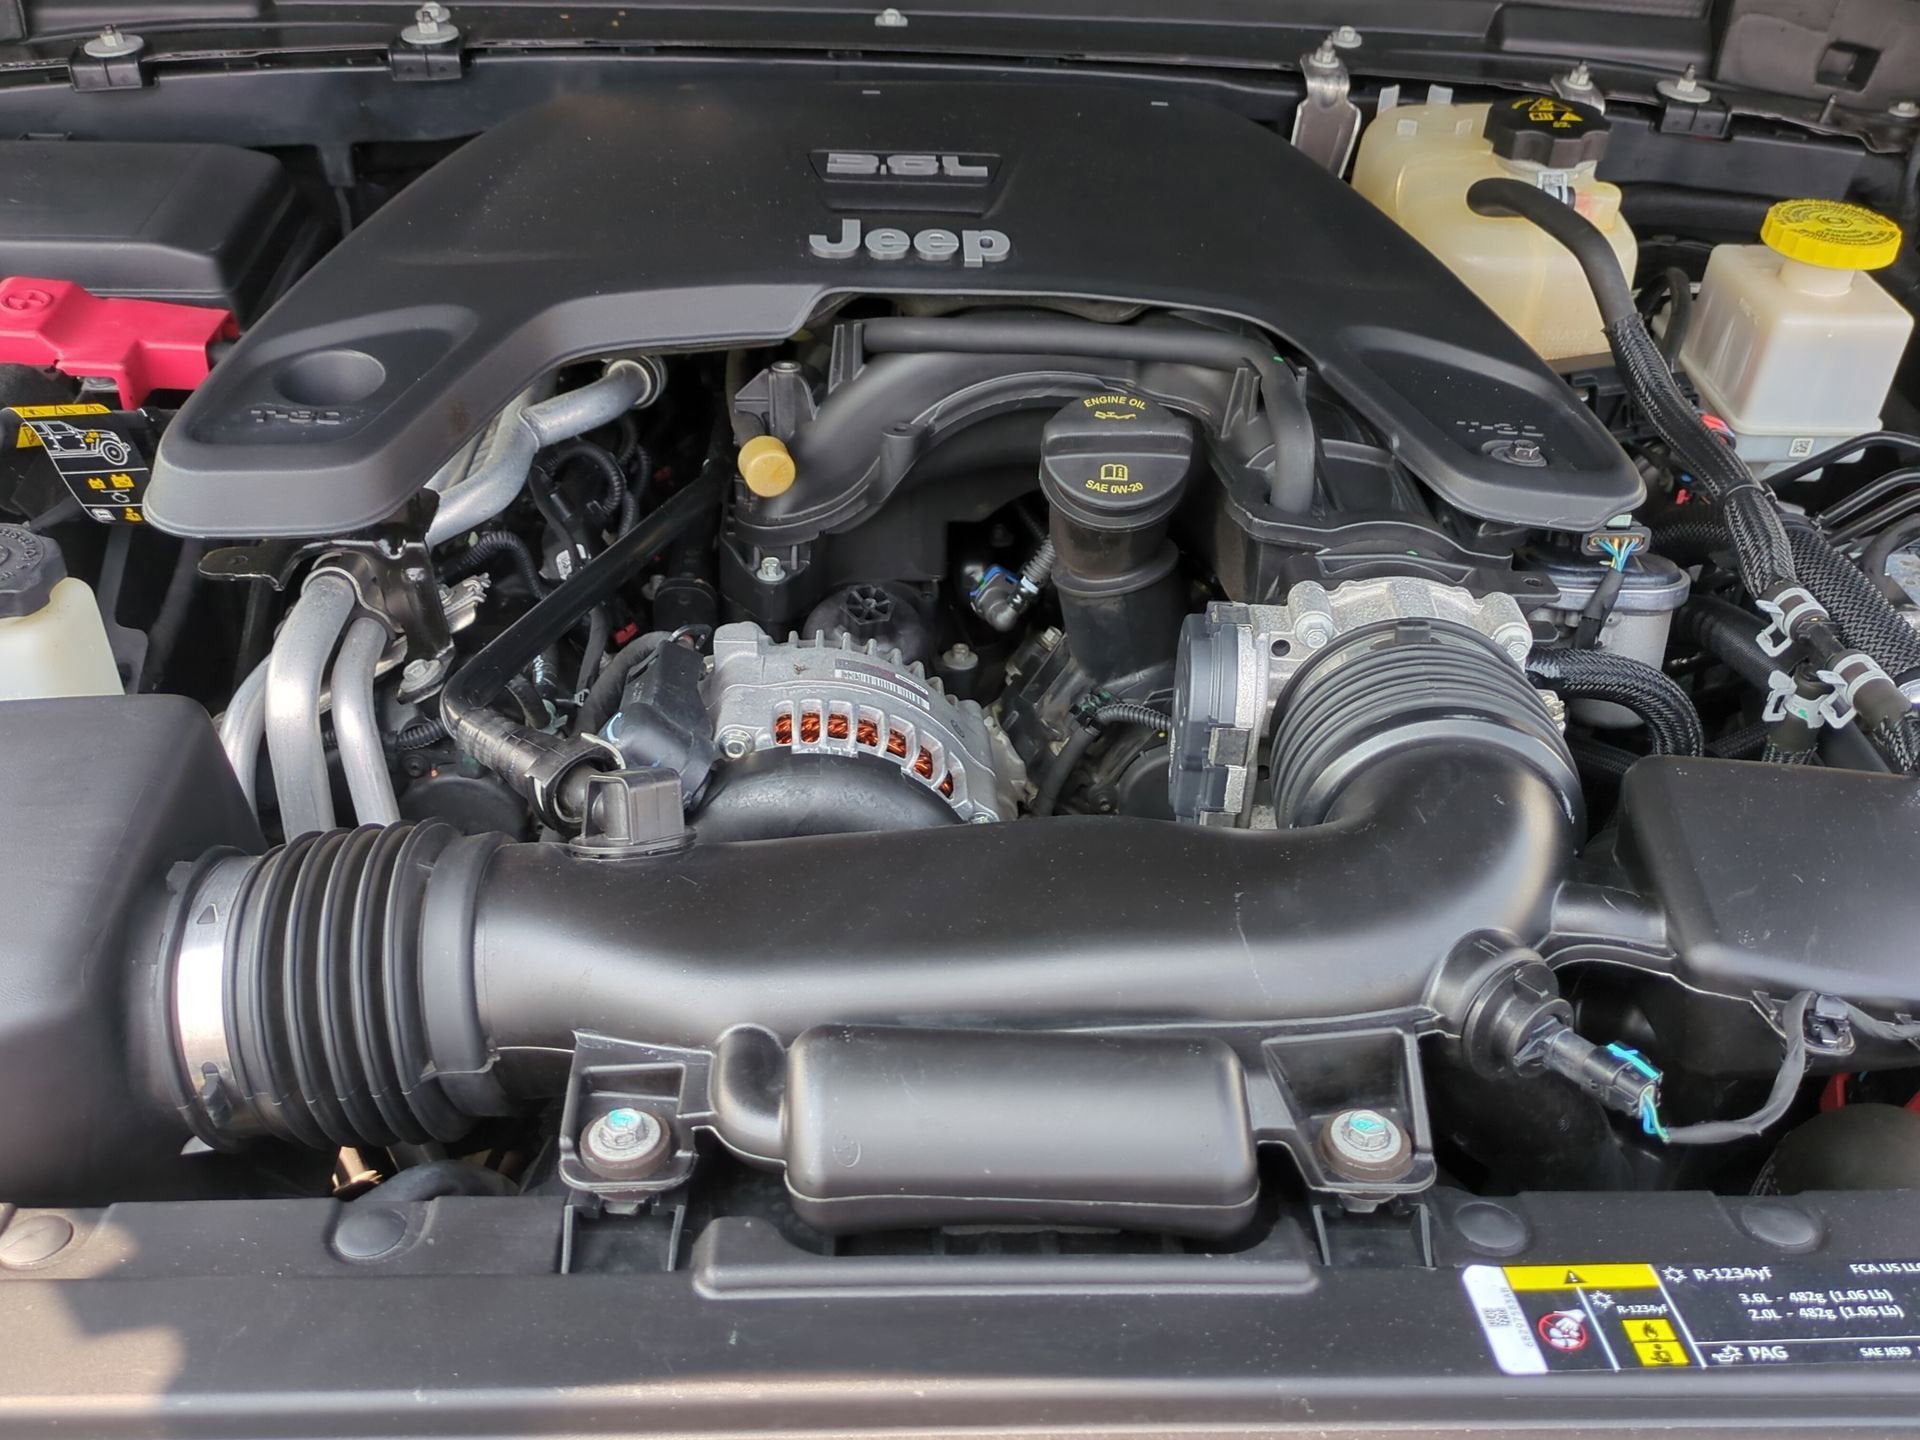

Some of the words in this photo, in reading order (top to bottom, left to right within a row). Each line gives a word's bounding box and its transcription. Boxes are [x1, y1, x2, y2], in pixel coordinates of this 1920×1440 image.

[809, 218, 1011, 267] Jeep
[1083, 395, 1126, 408] ENGINE
[1129, 398, 1146, 410] OIL
[1085, 479, 1108, 493] SAE
[1110, 482, 1144, 494] 0W-20
[1693, 1266, 1773, 1282] R-1234yf
[1849, 1263, 1880, 1275] FCA
[1879, 1263, 1901, 1273] US
[1738, 1292, 1773, 1304] 3.6L
[1789, 1290, 1827, 1304] 482g
[1829, 1289, 1869, 1302] (1.06
[1747, 1308, 1783, 1320] 2.0L
[1799, 1307, 1838, 1320] 482g
[1839, 1305, 1879, 1319] (1.06
[1747, 1345, 1790, 1360] PAG
[1859, 1346, 1885, 1358] SAE
